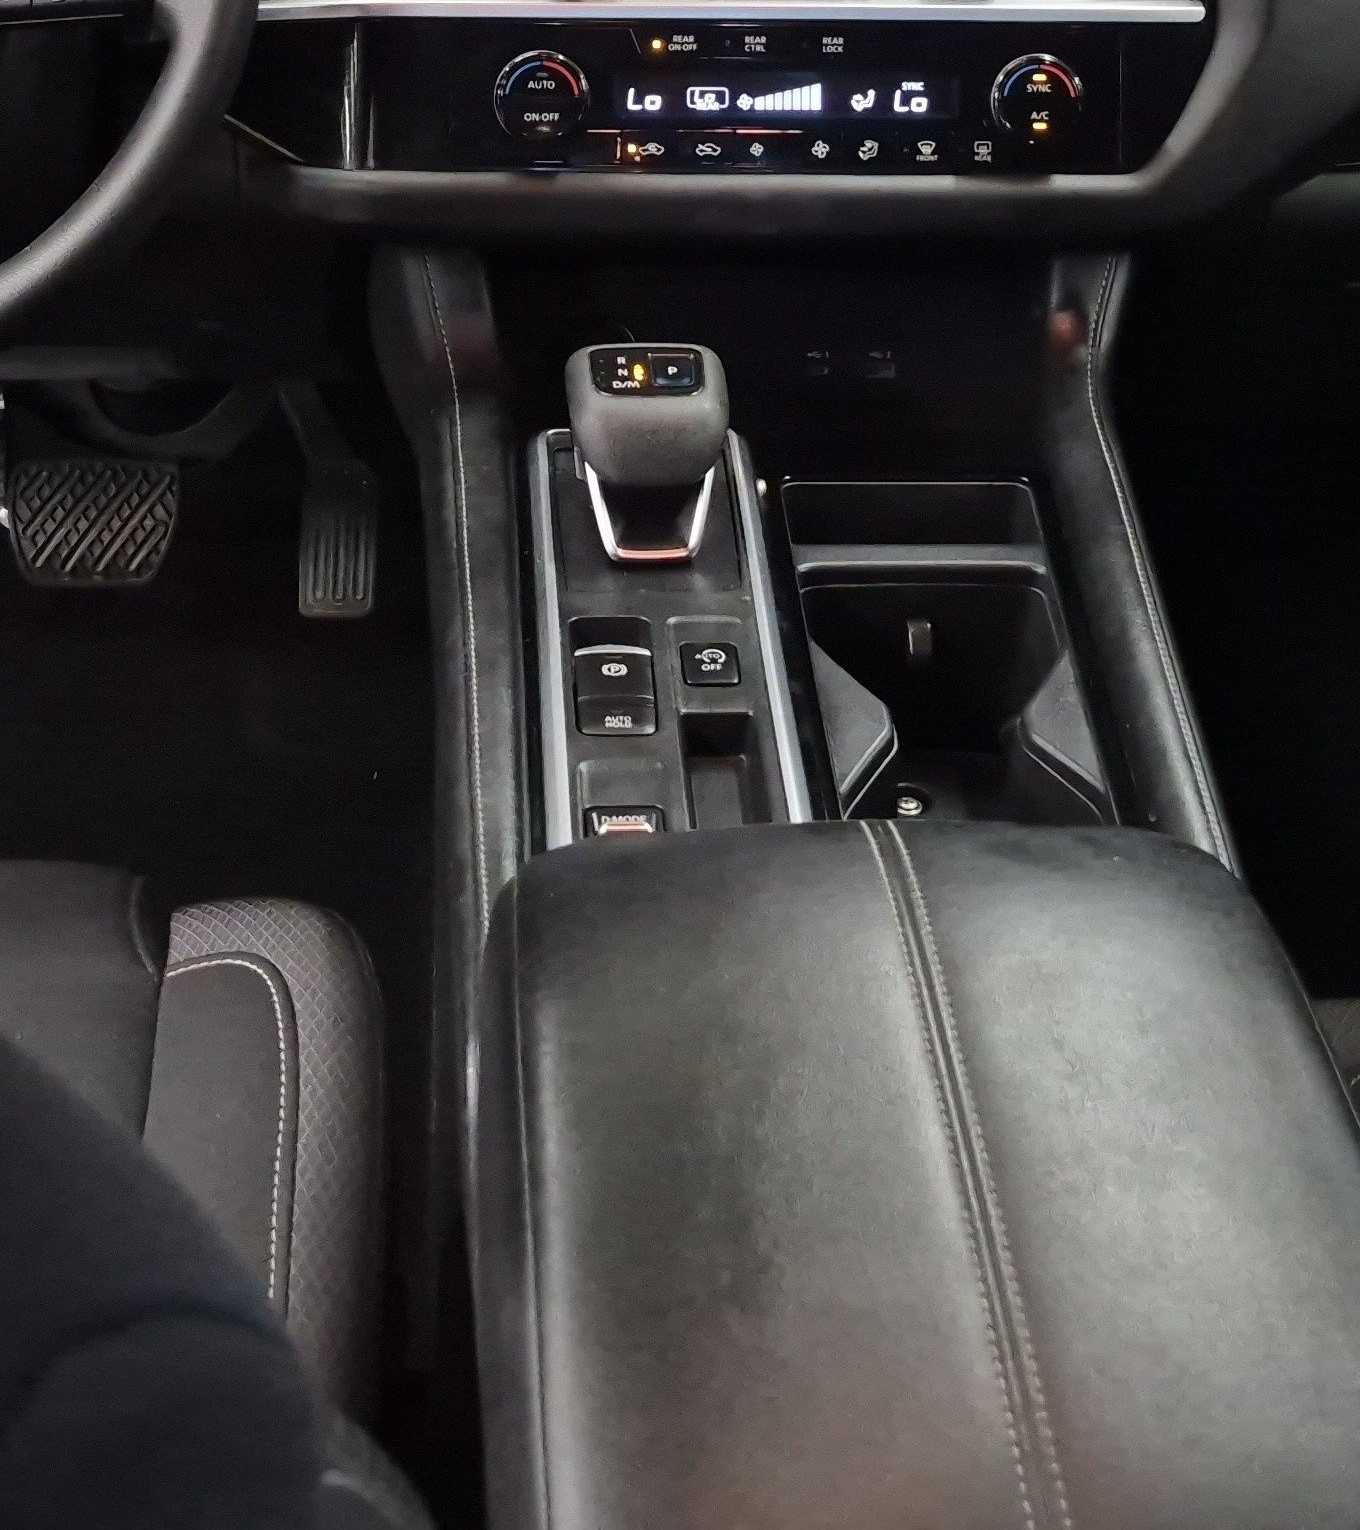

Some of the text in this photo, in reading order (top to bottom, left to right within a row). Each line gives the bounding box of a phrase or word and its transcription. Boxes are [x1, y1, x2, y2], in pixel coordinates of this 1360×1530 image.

[672, 35, 695, 43] REAR
[745, 35, 767, 44] REAR
[822, 37, 844, 45] REAR
[744, 44, 766, 53] CTRL
[822, 45, 844, 53] LOCK
[527, 80, 555, 90] AUTO
[901, 81, 925, 91] SYNC
[1025, 83, 1052, 93] SYNC
[627, 87, 662, 111] Lo
[893, 89, 928, 113] Lo
[1030, 111, 1050, 120] A/C
[916, 154, 938, 162] FRONT
[616, 356, 626, 365] R
[617, 368, 629, 377] N
[667, 365, 678, 376] P
[612, 380, 641, 389] D/M
[701, 663, 723, 672] OFF
[604, 715, 632, 723] AUTO
[604, 721, 632, 729] HOLD
